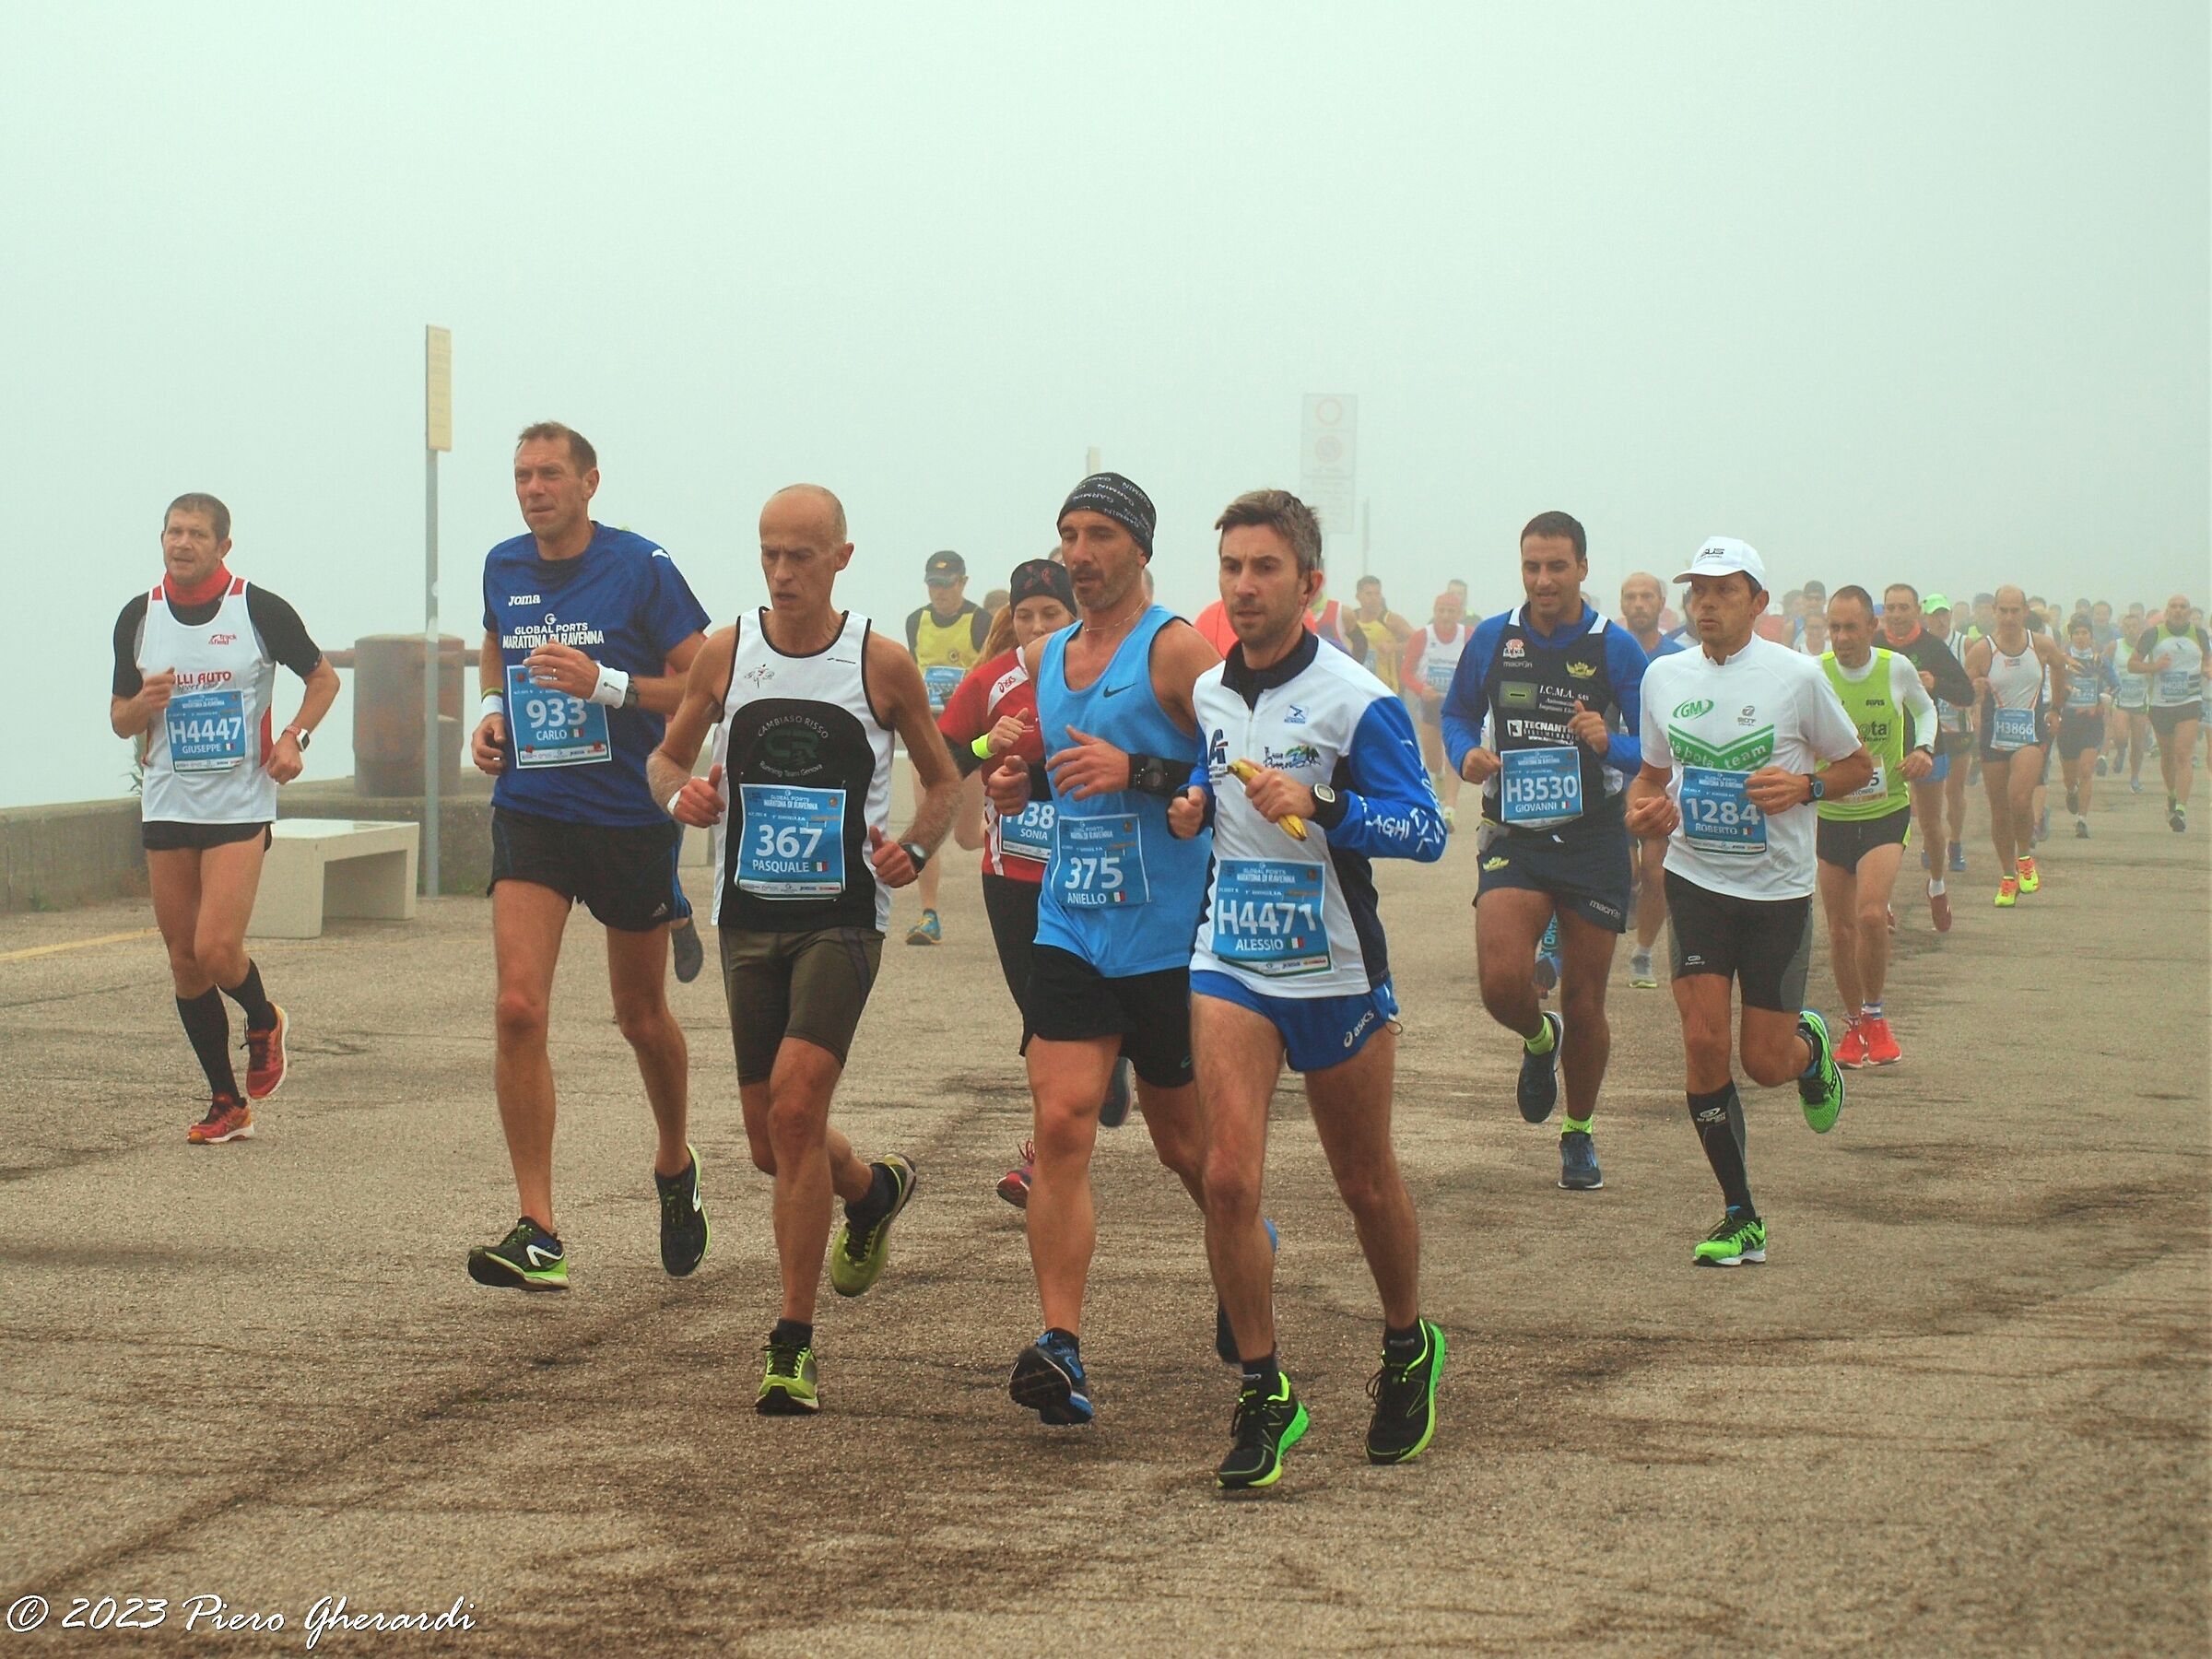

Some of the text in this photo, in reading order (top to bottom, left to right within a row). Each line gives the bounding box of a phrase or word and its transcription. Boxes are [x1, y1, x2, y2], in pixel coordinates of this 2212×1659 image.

[514, 622, 588, 635] GLOBAL PORTS
[502, 634, 547, 649] MARATONA
[559, 629, 605, 646] RAVENNA
[177, 671, 231, 685] LLI AUTO
[526, 698, 587, 728] 933
[169, 716, 242, 744] H4447
[758, 715, 829, 738] CAMBIASO RISSO
[1995, 721, 2033, 735] H3866
[536, 729, 568, 741] CARLO
[182, 743, 221, 754] GIUSEPPE
[1724, 744, 1767, 769] team
[1506, 775, 1579, 803] H3530
[1515, 802, 1558, 813] GIOVANNI
[1686, 797, 1760, 827] 1284
[1020, 828, 1048, 841] SONIA
[1695, 822, 1737, 836] ROBERTO
[756, 824, 823, 858] 367
[752, 859, 810, 874] PASQUALE
[1065, 856, 1124, 889] 375
[1067, 892, 1106, 905] ANIELLO
[1218, 899, 1317, 935] H4471
[1235, 938, 1284, 951] ALESSIO
